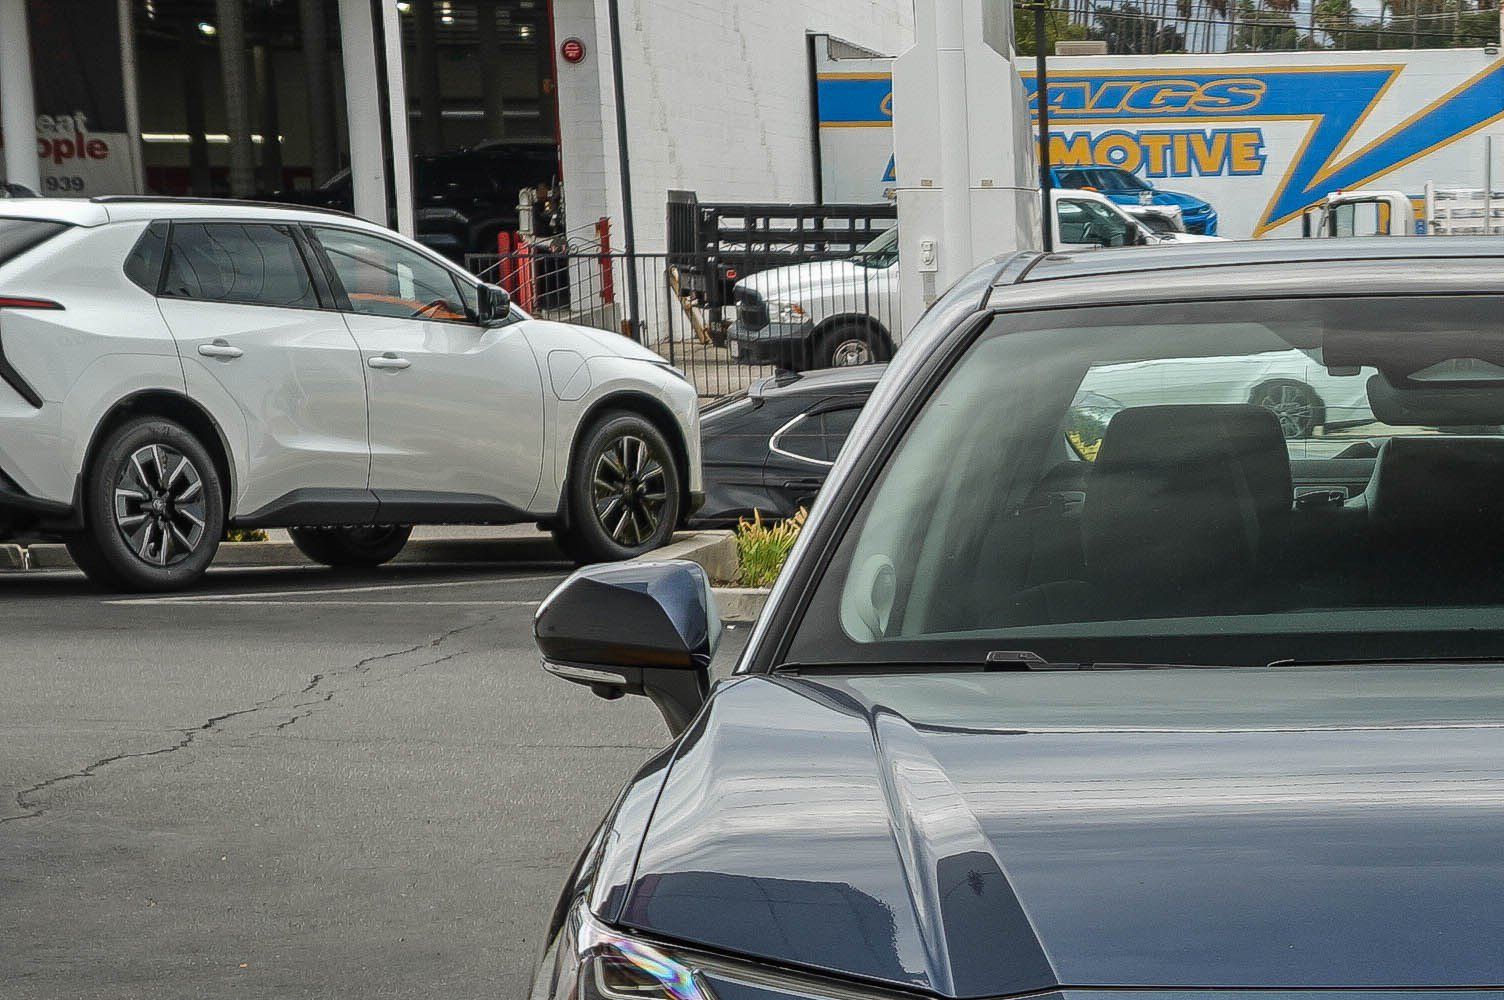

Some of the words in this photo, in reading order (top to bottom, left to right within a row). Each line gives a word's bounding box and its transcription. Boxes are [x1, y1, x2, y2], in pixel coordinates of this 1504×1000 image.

[881, 78, 1267, 115] AIGS
[37, 111, 88, 134] eat
[37, 131, 110, 165] ople
[881, 127, 1268, 182] MOTIVE
